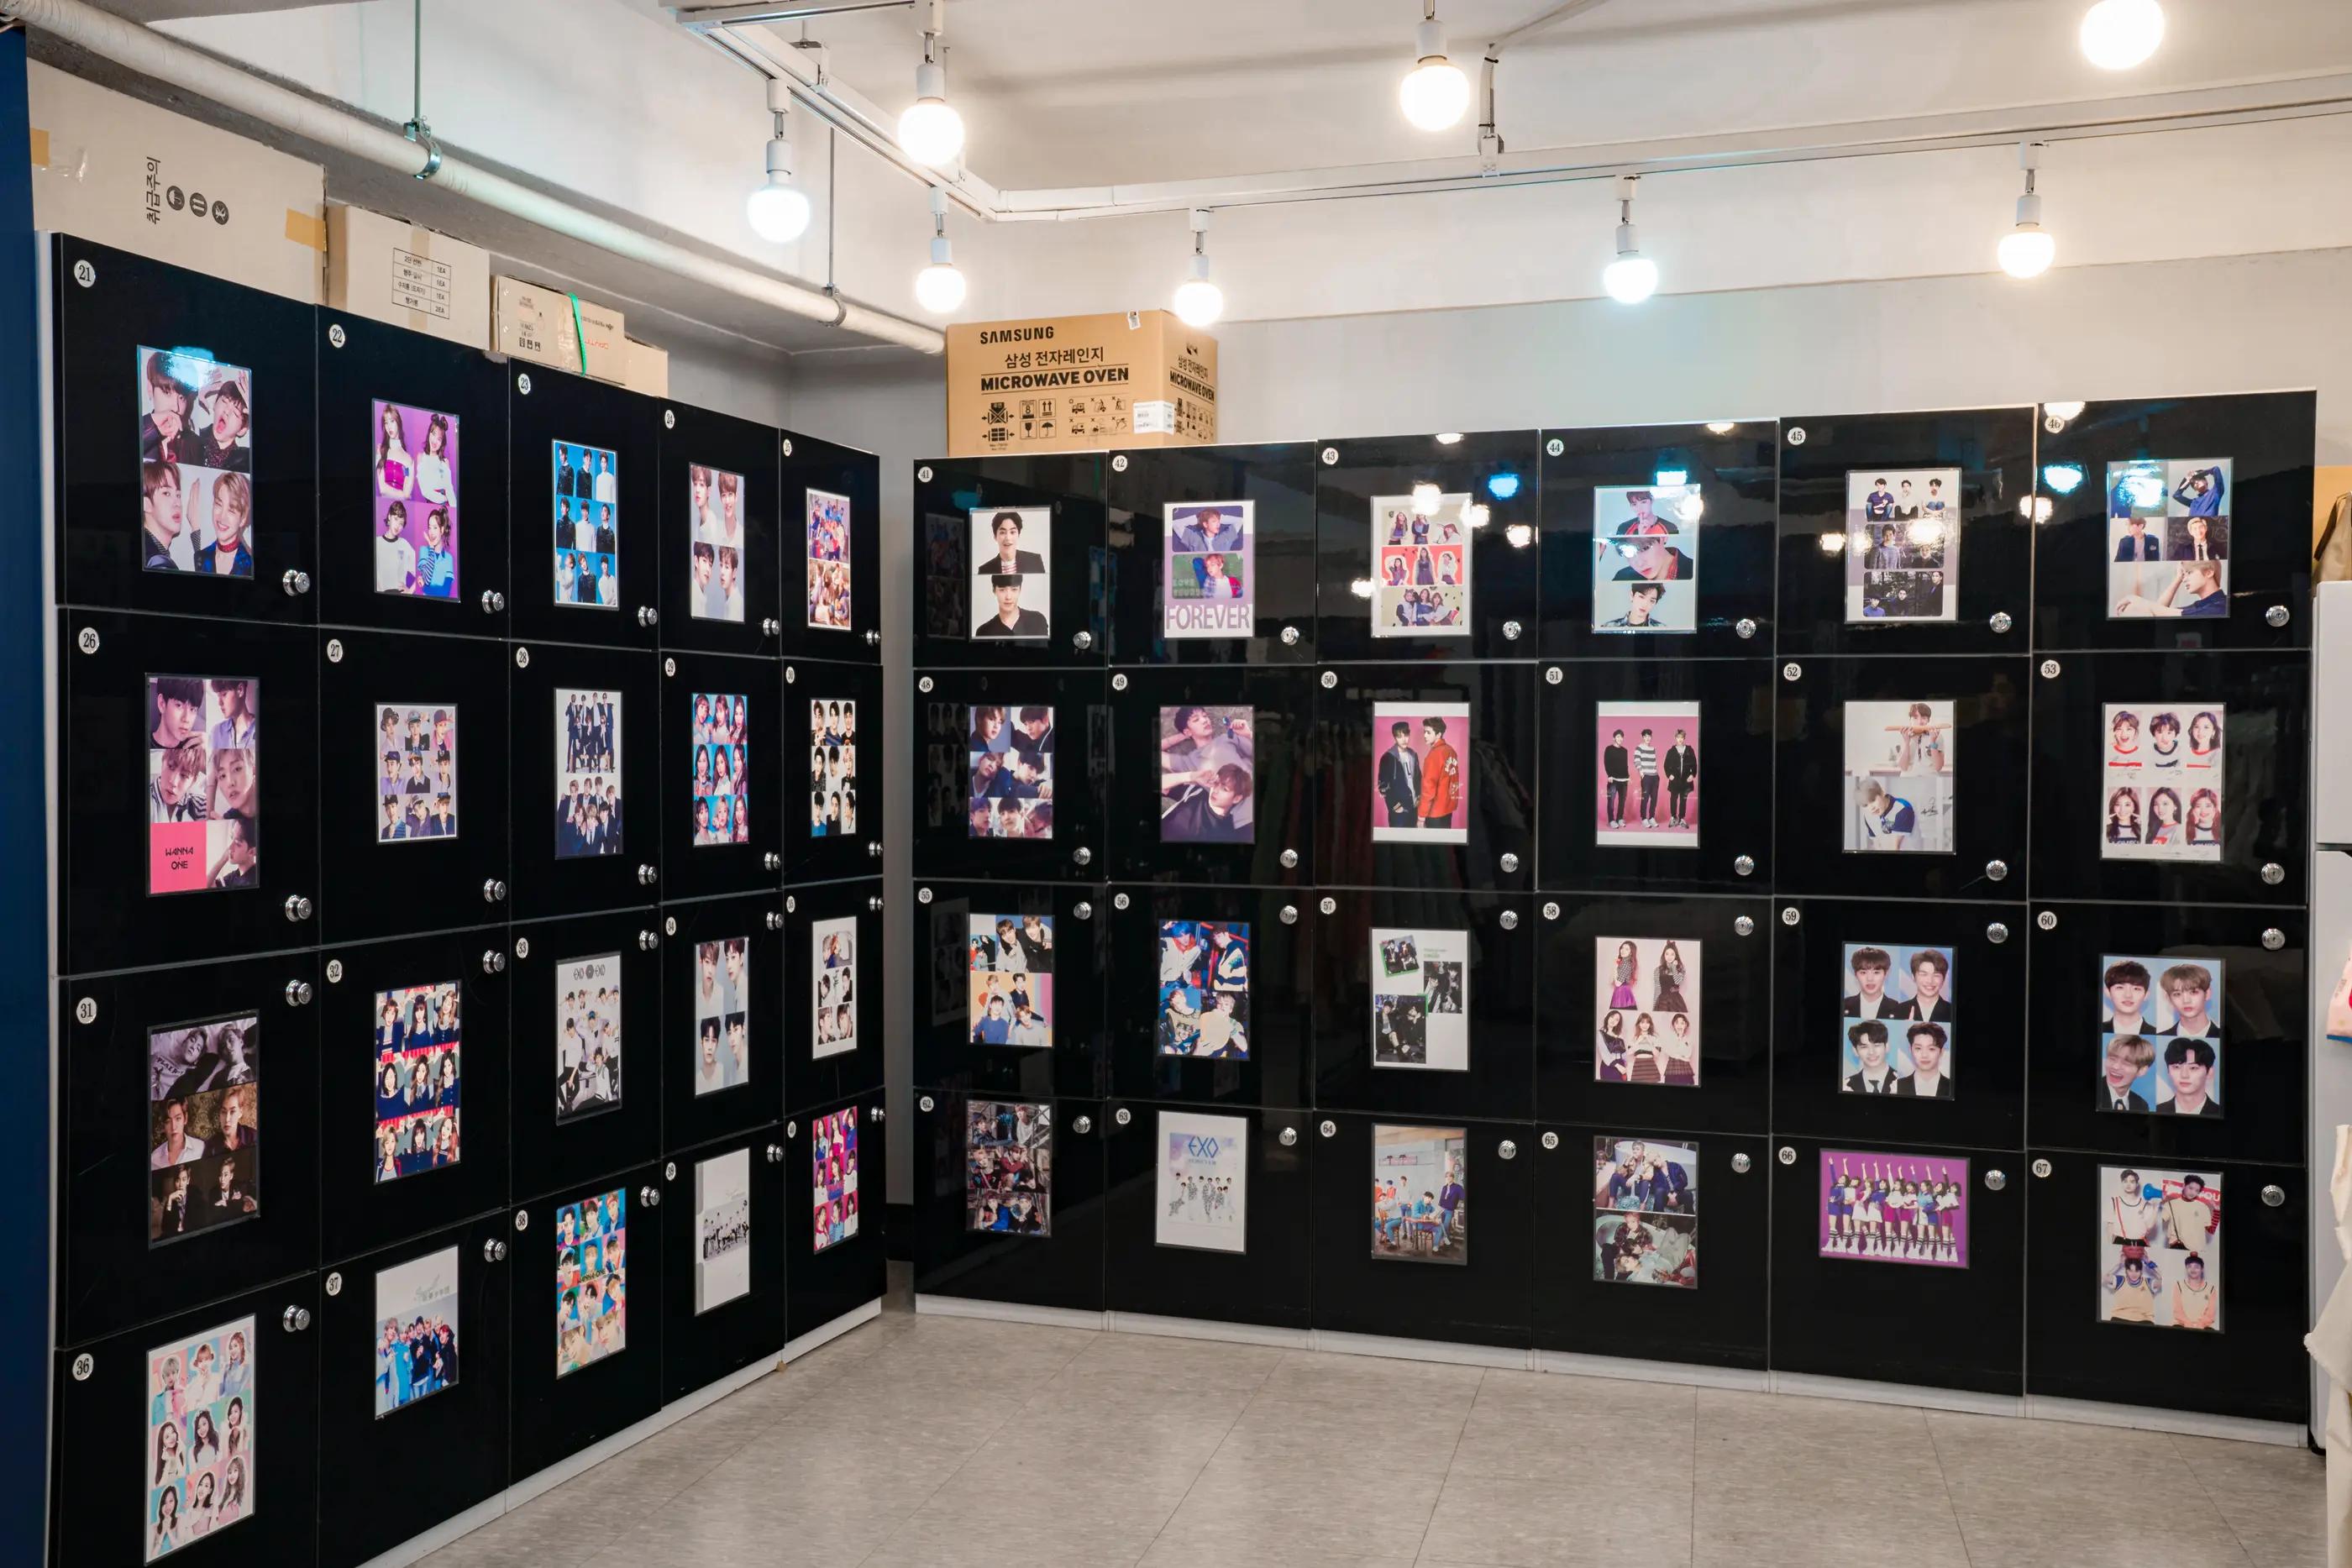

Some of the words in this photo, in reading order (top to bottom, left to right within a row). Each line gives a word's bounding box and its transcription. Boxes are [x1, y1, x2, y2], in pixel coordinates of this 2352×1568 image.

[146, 156, 160, 224] 취급주의
[79, 265, 91, 281] 21
[437, 265, 446, 275] 1EA
[436, 278, 446, 287] 1EA
[436, 291, 445, 301] 1EA
[333, 328, 342, 343] 22
[980, 326, 1054, 344] SAMSUNG
[1005, 351, 1032, 370] 삼성
[1035, 346, 1104, 366] 전자레인지
[521, 377, 528, 390] 23
[981, 371, 1080, 391] MICROWAVE
[1084, 367, 1129, 384] OVEN
[1170, 370, 1202, 396] MICROWAVE
[1202, 385, 1215, 402] OVEN
[1025, 405, 1032, 414] 8
[2048, 418, 2061, 428] 46
[1791, 431, 1803, 441] 45
[1550, 443, 1560, 452] 44
[1326, 451, 1335, 460] 43
[1115, 459, 1125, 468] 42
[921, 470, 930, 479] 41
[1166, 604, 1251, 630] FOREVER
[83, 632, 96, 648] 26
[330, 643, 339, 657] 27
[519, 651, 527, 663] 28
[1787, 667, 1798, 677] 52
[2045, 663, 2056, 674] 53
[1324, 675, 1334, 684] 50
[1549, 671, 1558, 681] 51
[921, 680, 931, 689] 48
[1115, 677, 1125, 686] 49
[165, 847, 194, 856] WANNA
[171, 860, 188, 870] ONE
[921, 891, 930, 899] 55
[1117, 897, 1126, 906] 56
[1324, 901, 1332, 910] 57
[1546, 906, 1557, 916] 58
[1786, 911, 1797, 921] 59
[2041, 915, 2054, 926] 60
[518, 941, 527, 954] 33
[329, 964, 339, 978] 32
[81, 1003, 92, 1019] 31
[922, 1099, 932, 1109] 62
[1119, 1112, 1128, 1121] 63
[1323, 1124, 1333, 1134] 64
[1545, 1135, 1555, 1146] 65
[1188, 1135, 1219, 1158] EXO
[1782, 1151, 1793, 1161] 66
[2036, 1162, 2048, 1173] 67
[517, 1214, 526, 1227] 38
[329, 1277, 339, 1292] 37
[76, 1358, 89, 1376] 36
